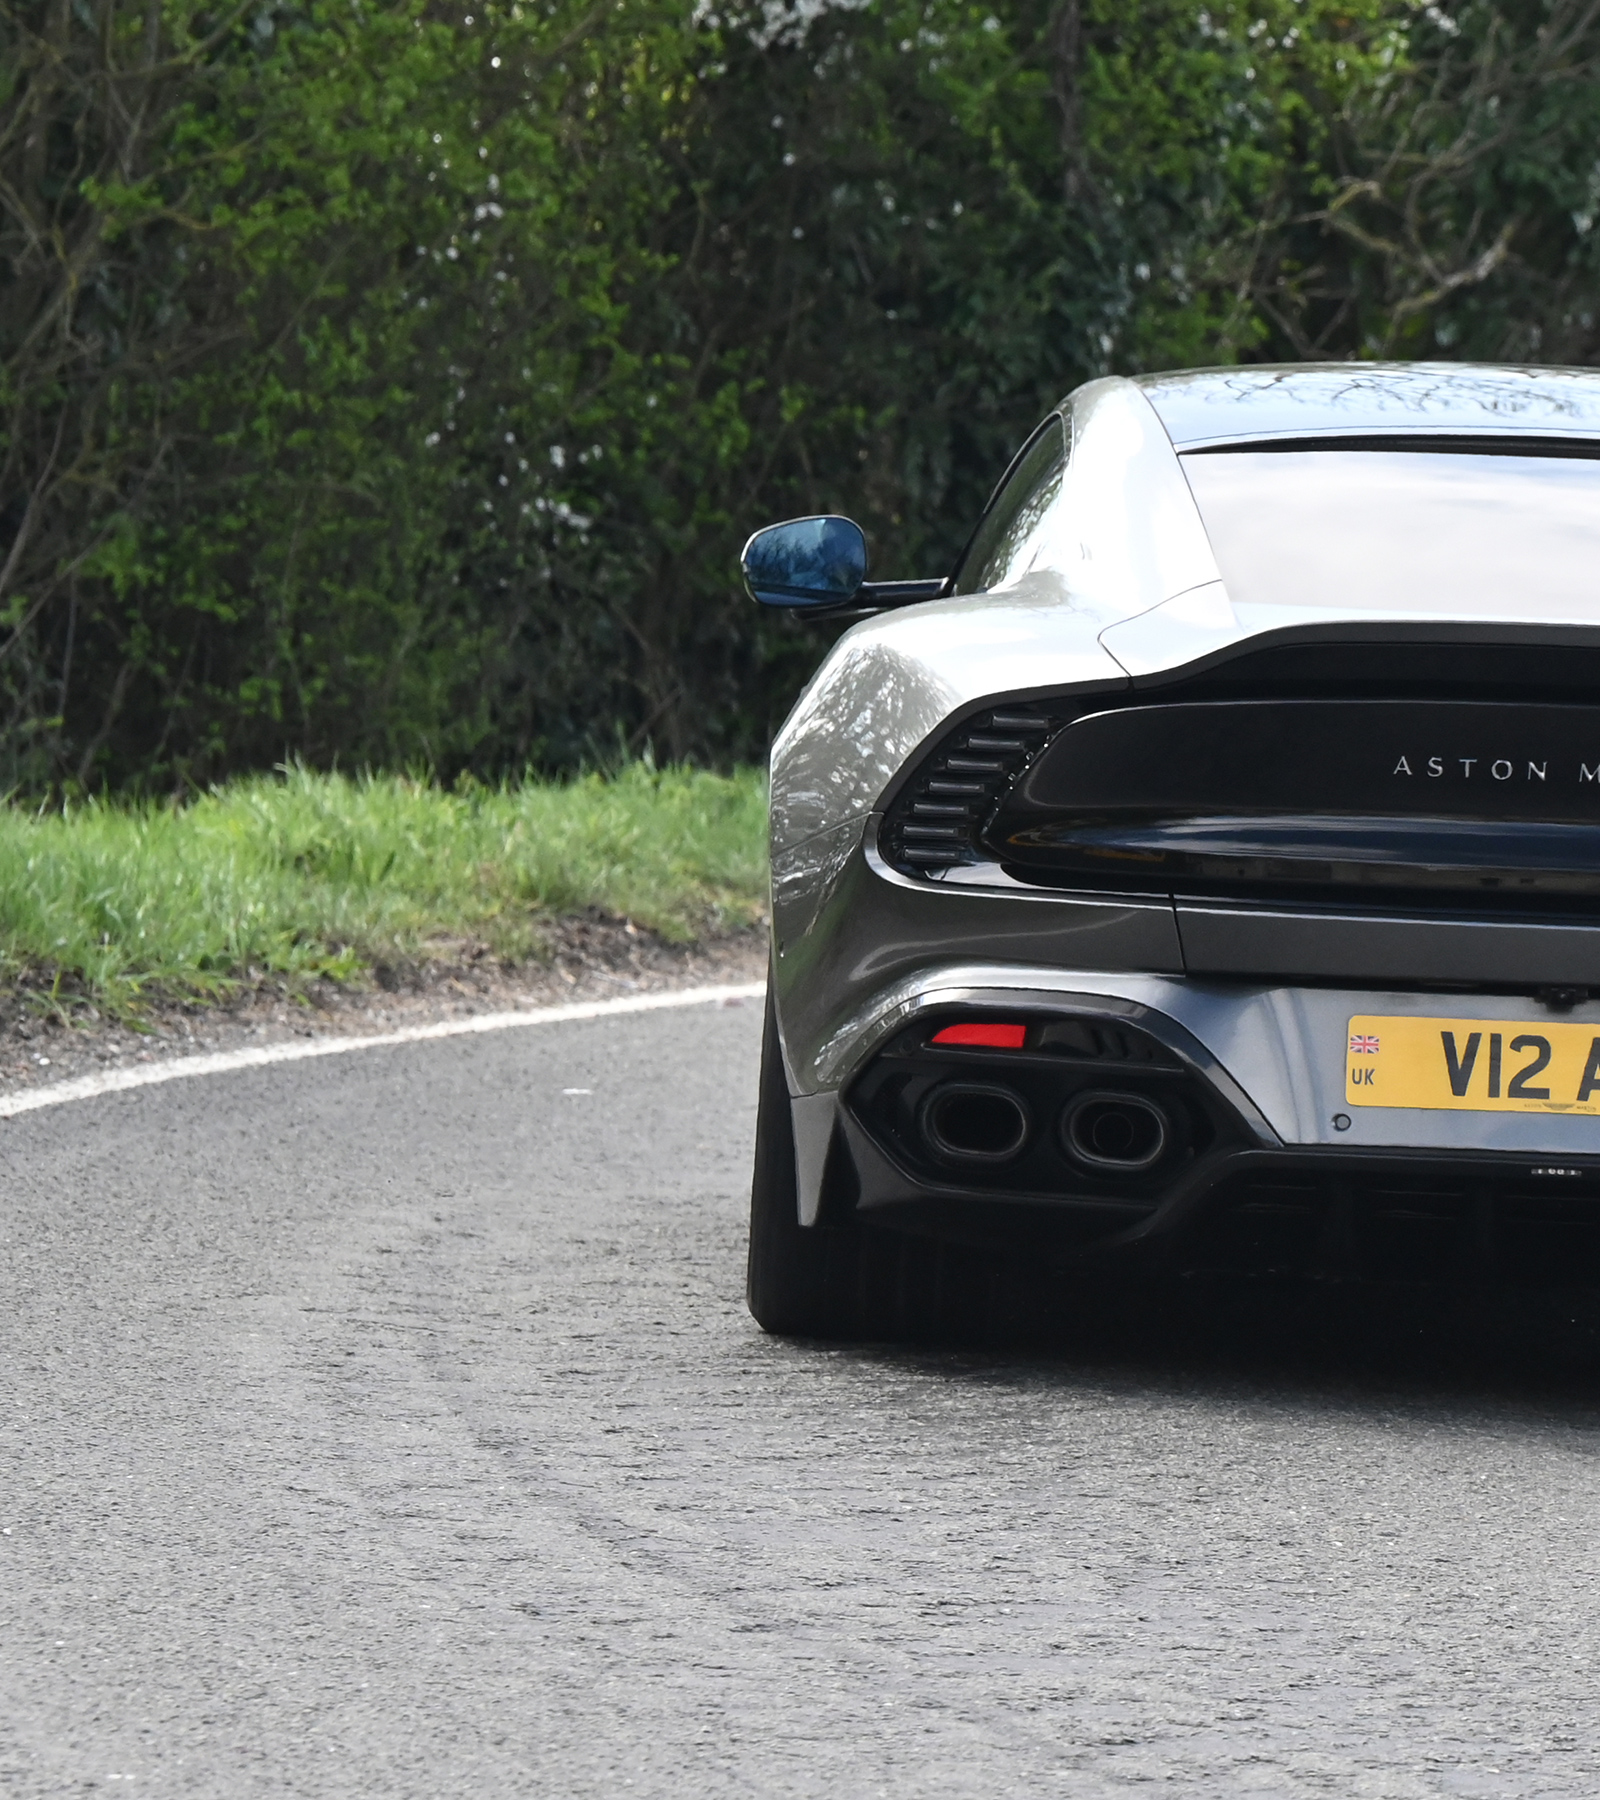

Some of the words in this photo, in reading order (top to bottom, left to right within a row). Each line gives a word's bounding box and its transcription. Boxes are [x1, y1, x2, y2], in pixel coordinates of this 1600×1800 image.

[1393, 755, 1548, 781] ASTON
[1351, 1068, 1375, 1085] UK
[1440, 1031, 1552, 1100] V12
